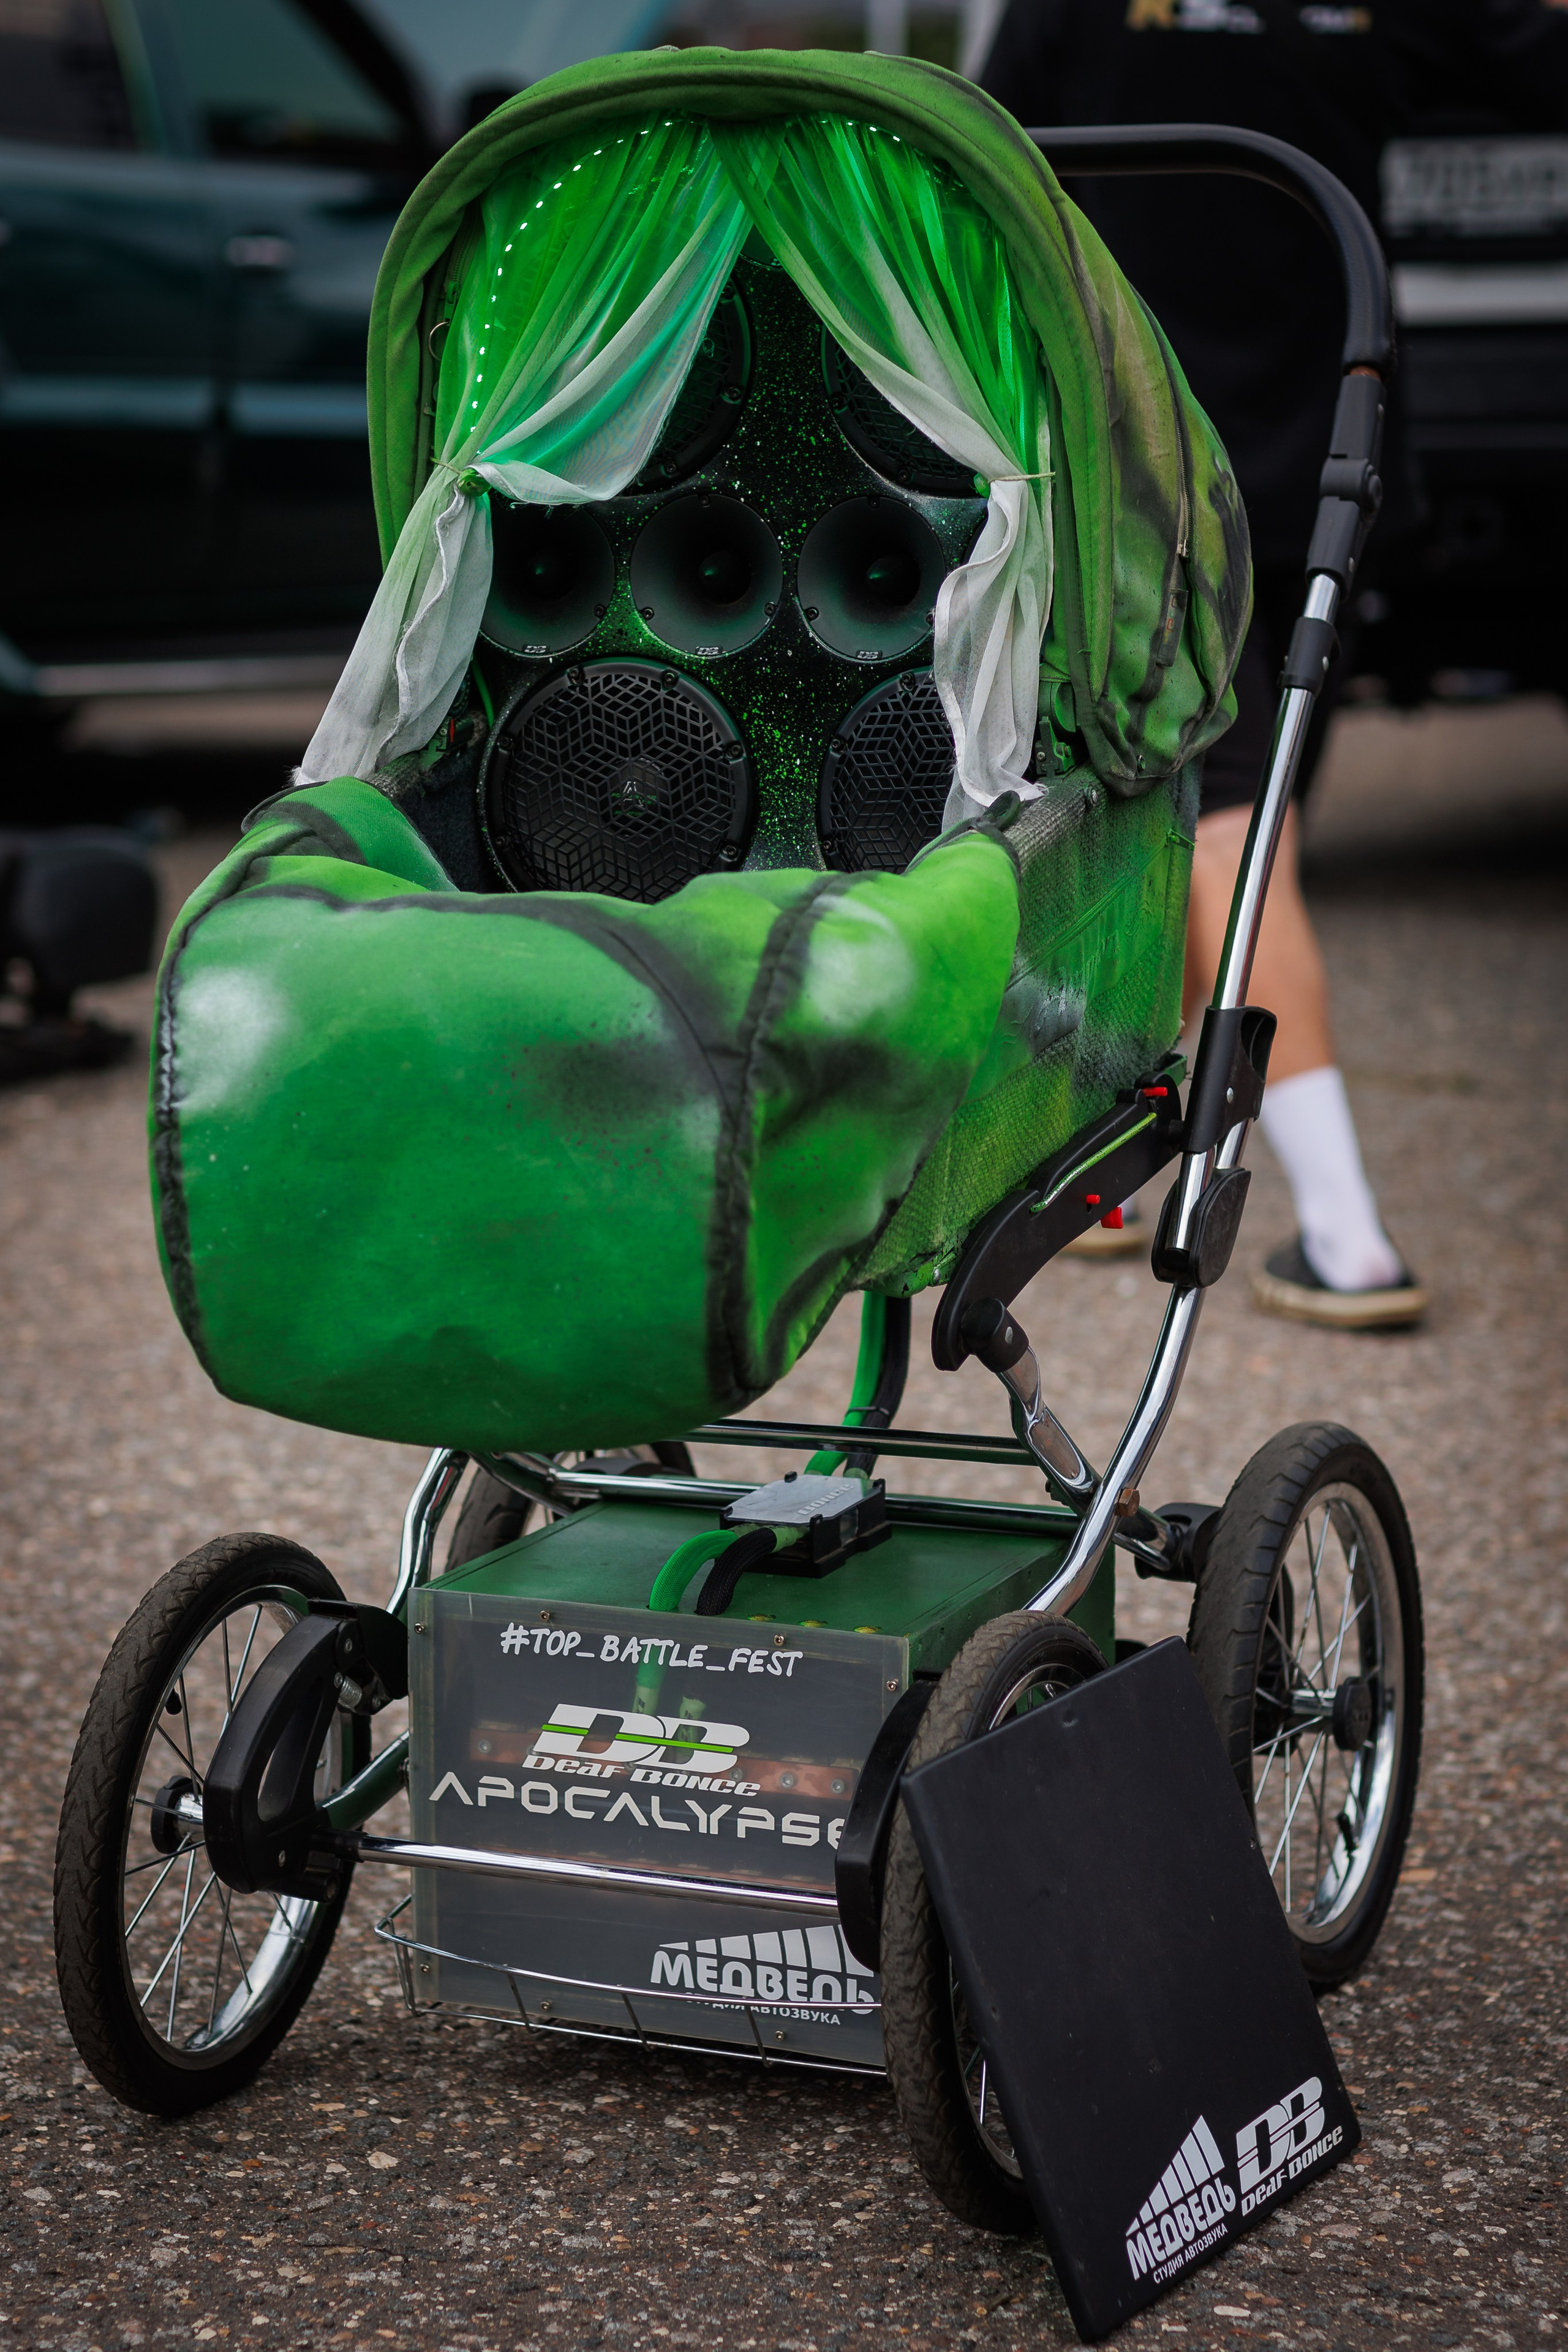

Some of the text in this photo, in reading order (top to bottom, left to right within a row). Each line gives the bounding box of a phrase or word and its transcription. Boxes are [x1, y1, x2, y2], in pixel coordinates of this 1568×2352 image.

[500, 1622, 803, 1677] #TOP_BATTLE_FEST
[650, 1950, 875, 2015] МЕДВЕДЬ
[1125, 2177, 1236, 2281] МЕДВЕДЬ
[1153, 2224, 1228, 2284] СТУДИЯ АВТОЗВУКА
